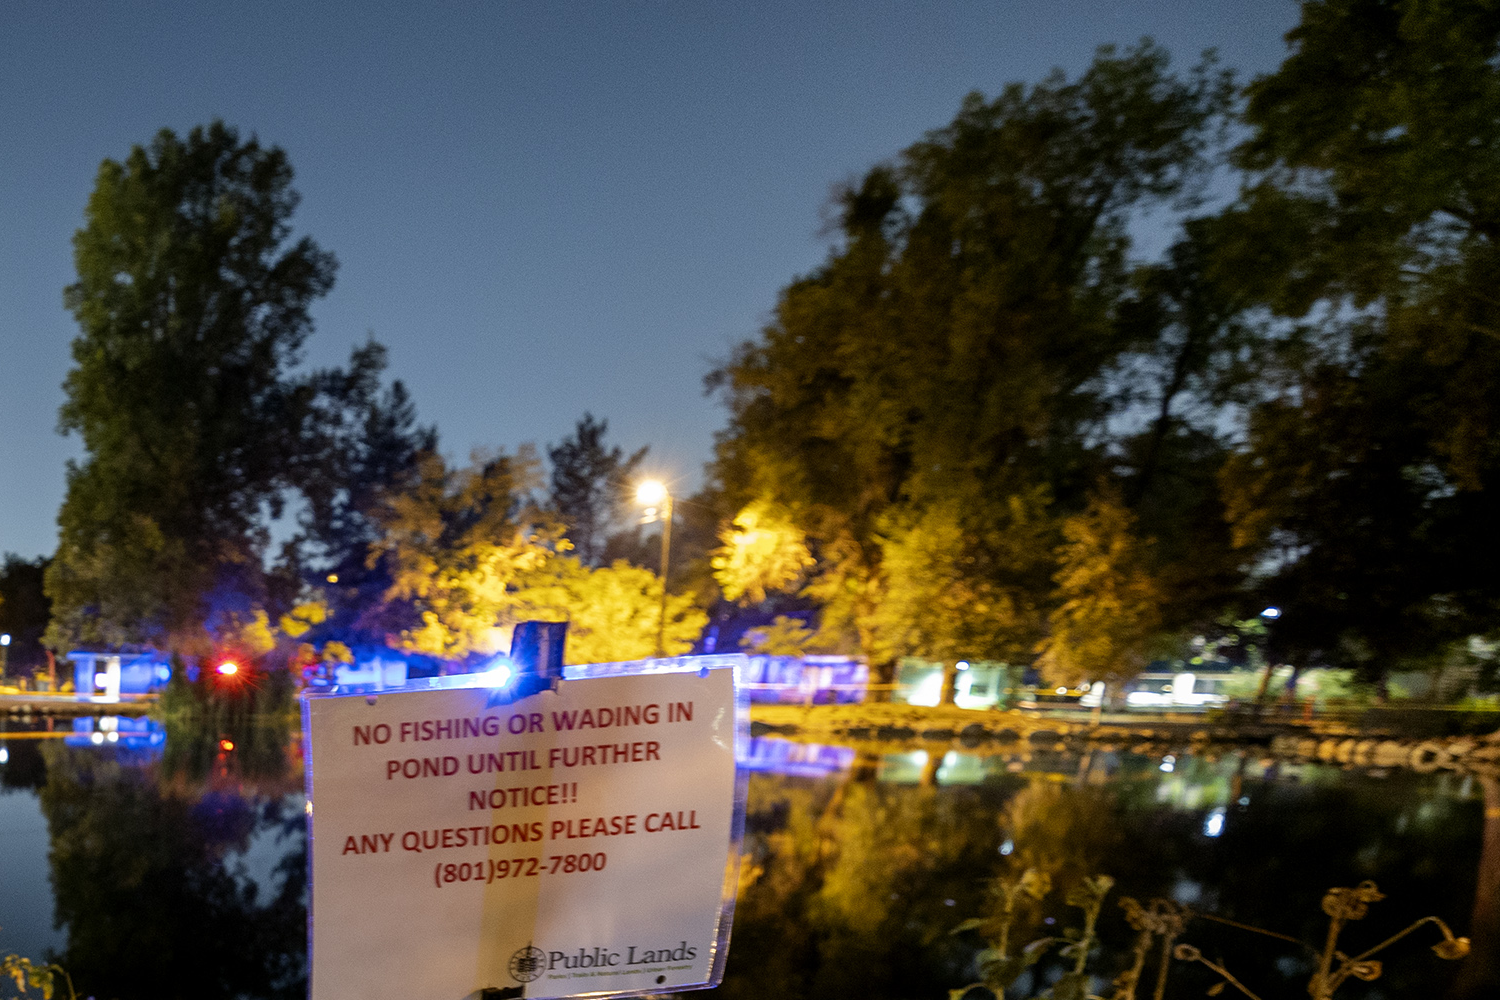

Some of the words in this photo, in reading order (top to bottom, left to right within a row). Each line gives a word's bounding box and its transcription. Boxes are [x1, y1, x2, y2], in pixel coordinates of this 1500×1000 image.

[353, 724, 392, 746] NO
[400, 716, 499, 742] FISHING
[507, 712, 543, 734] OR
[552, 703, 660, 731] WADING
[668, 702, 693, 722] IN
[387, 756, 459, 780] POND
[468, 750, 541, 775] UNTIL
[549, 741, 660, 768] FURTHER
[468, 782, 578, 811] NOTICE!!
[342, 833, 394, 855] ANY
[401, 821, 543, 852] QUESTIONS
[551, 815, 636, 840] PLEASE
[644, 810, 700, 832] CALL
[435, 852, 606, 888] (801)972-7800
[548, 947, 620, 970] Public
[627, 941, 697, 965] Lands
